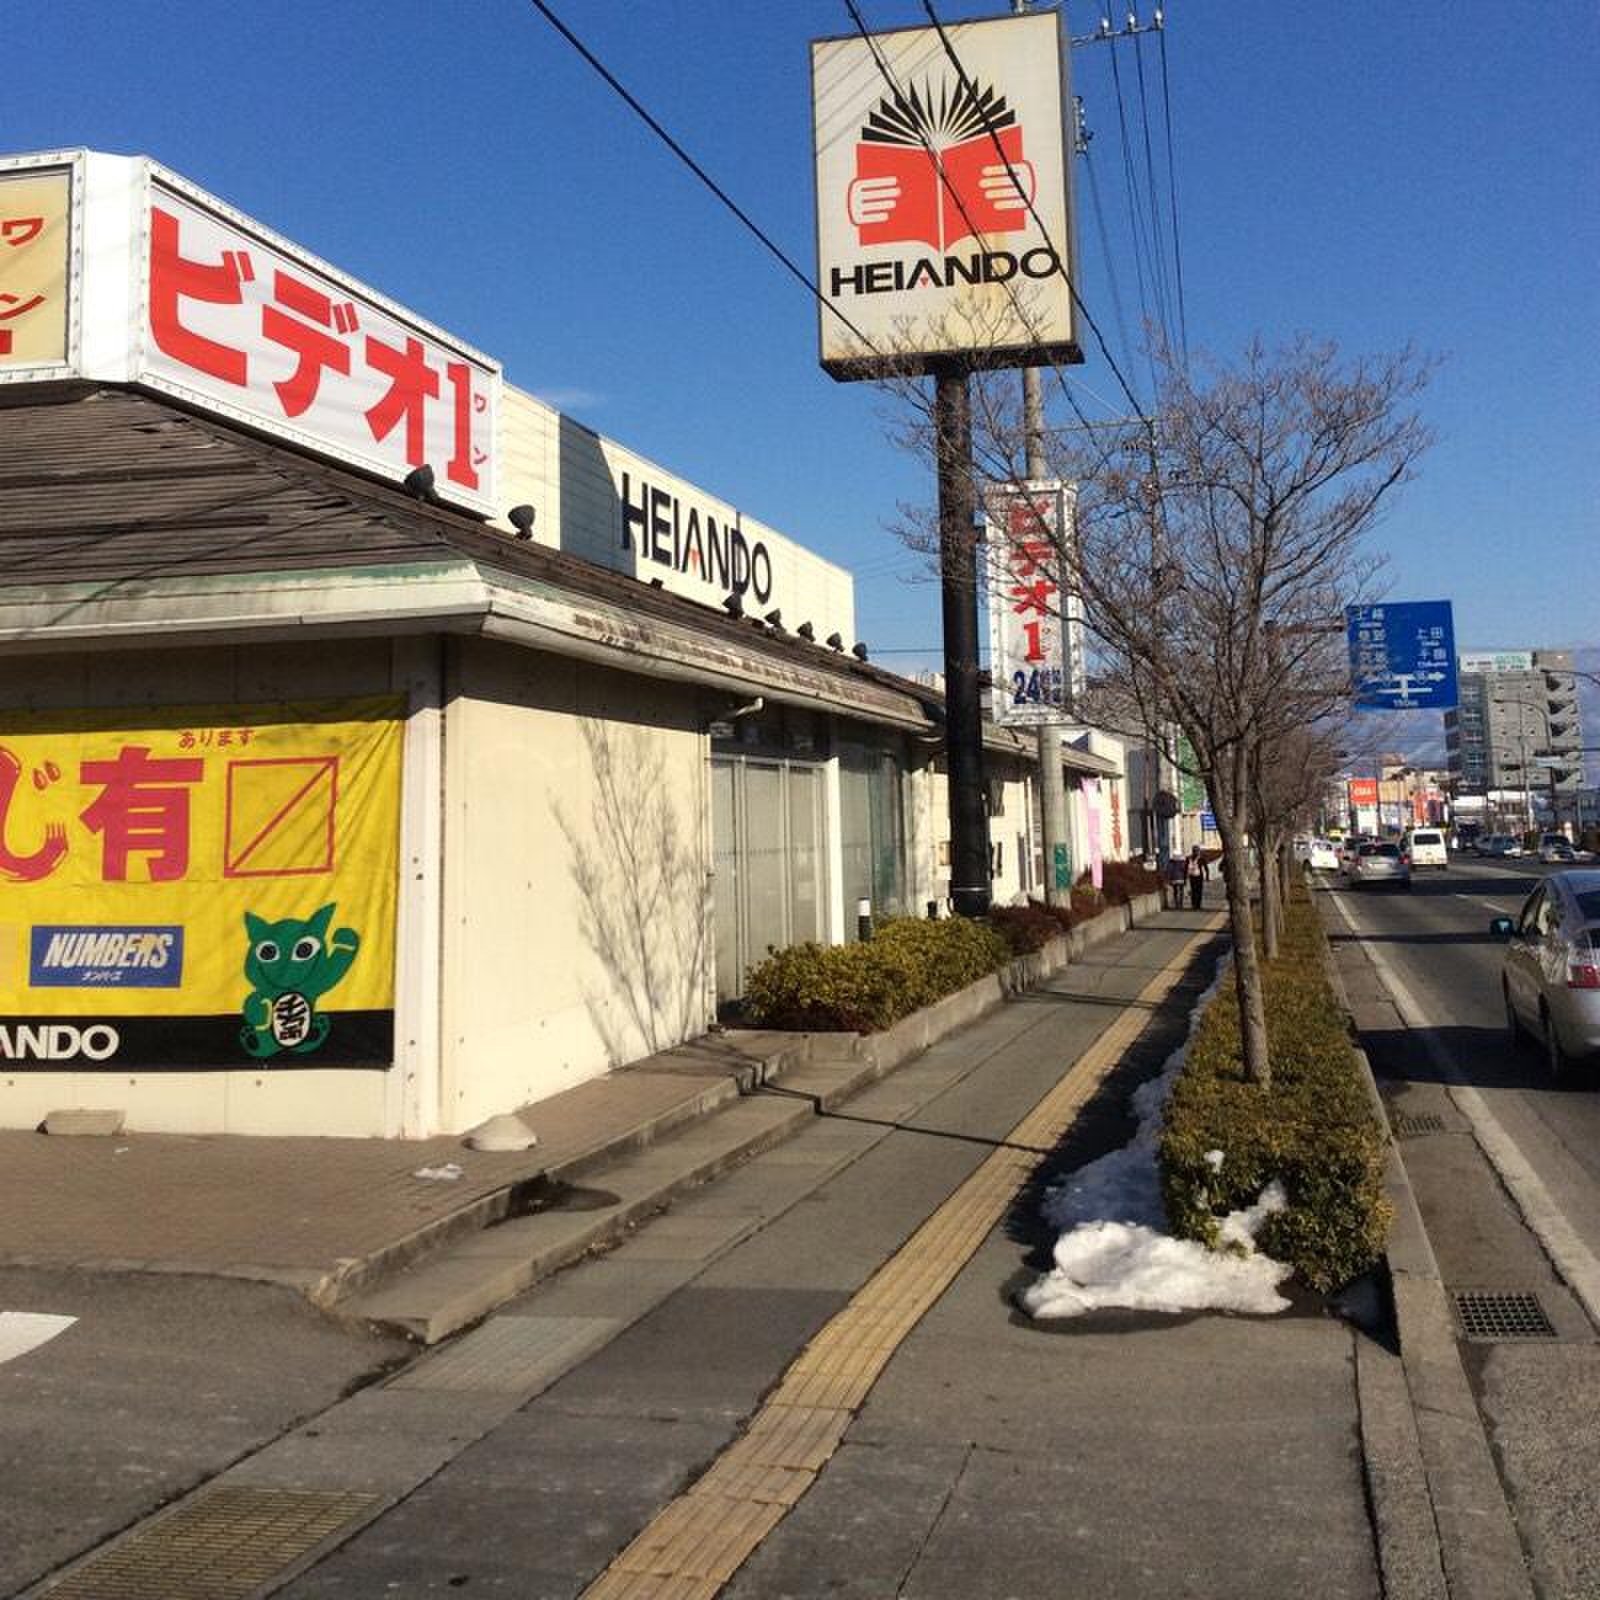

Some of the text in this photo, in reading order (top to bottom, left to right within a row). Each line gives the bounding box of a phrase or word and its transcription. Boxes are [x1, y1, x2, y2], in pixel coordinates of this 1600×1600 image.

[830, 247, 1060, 297] HEIANDO
[621, 472, 773, 605] HEIANDO
[42, 933, 174, 968] NUMBERS
